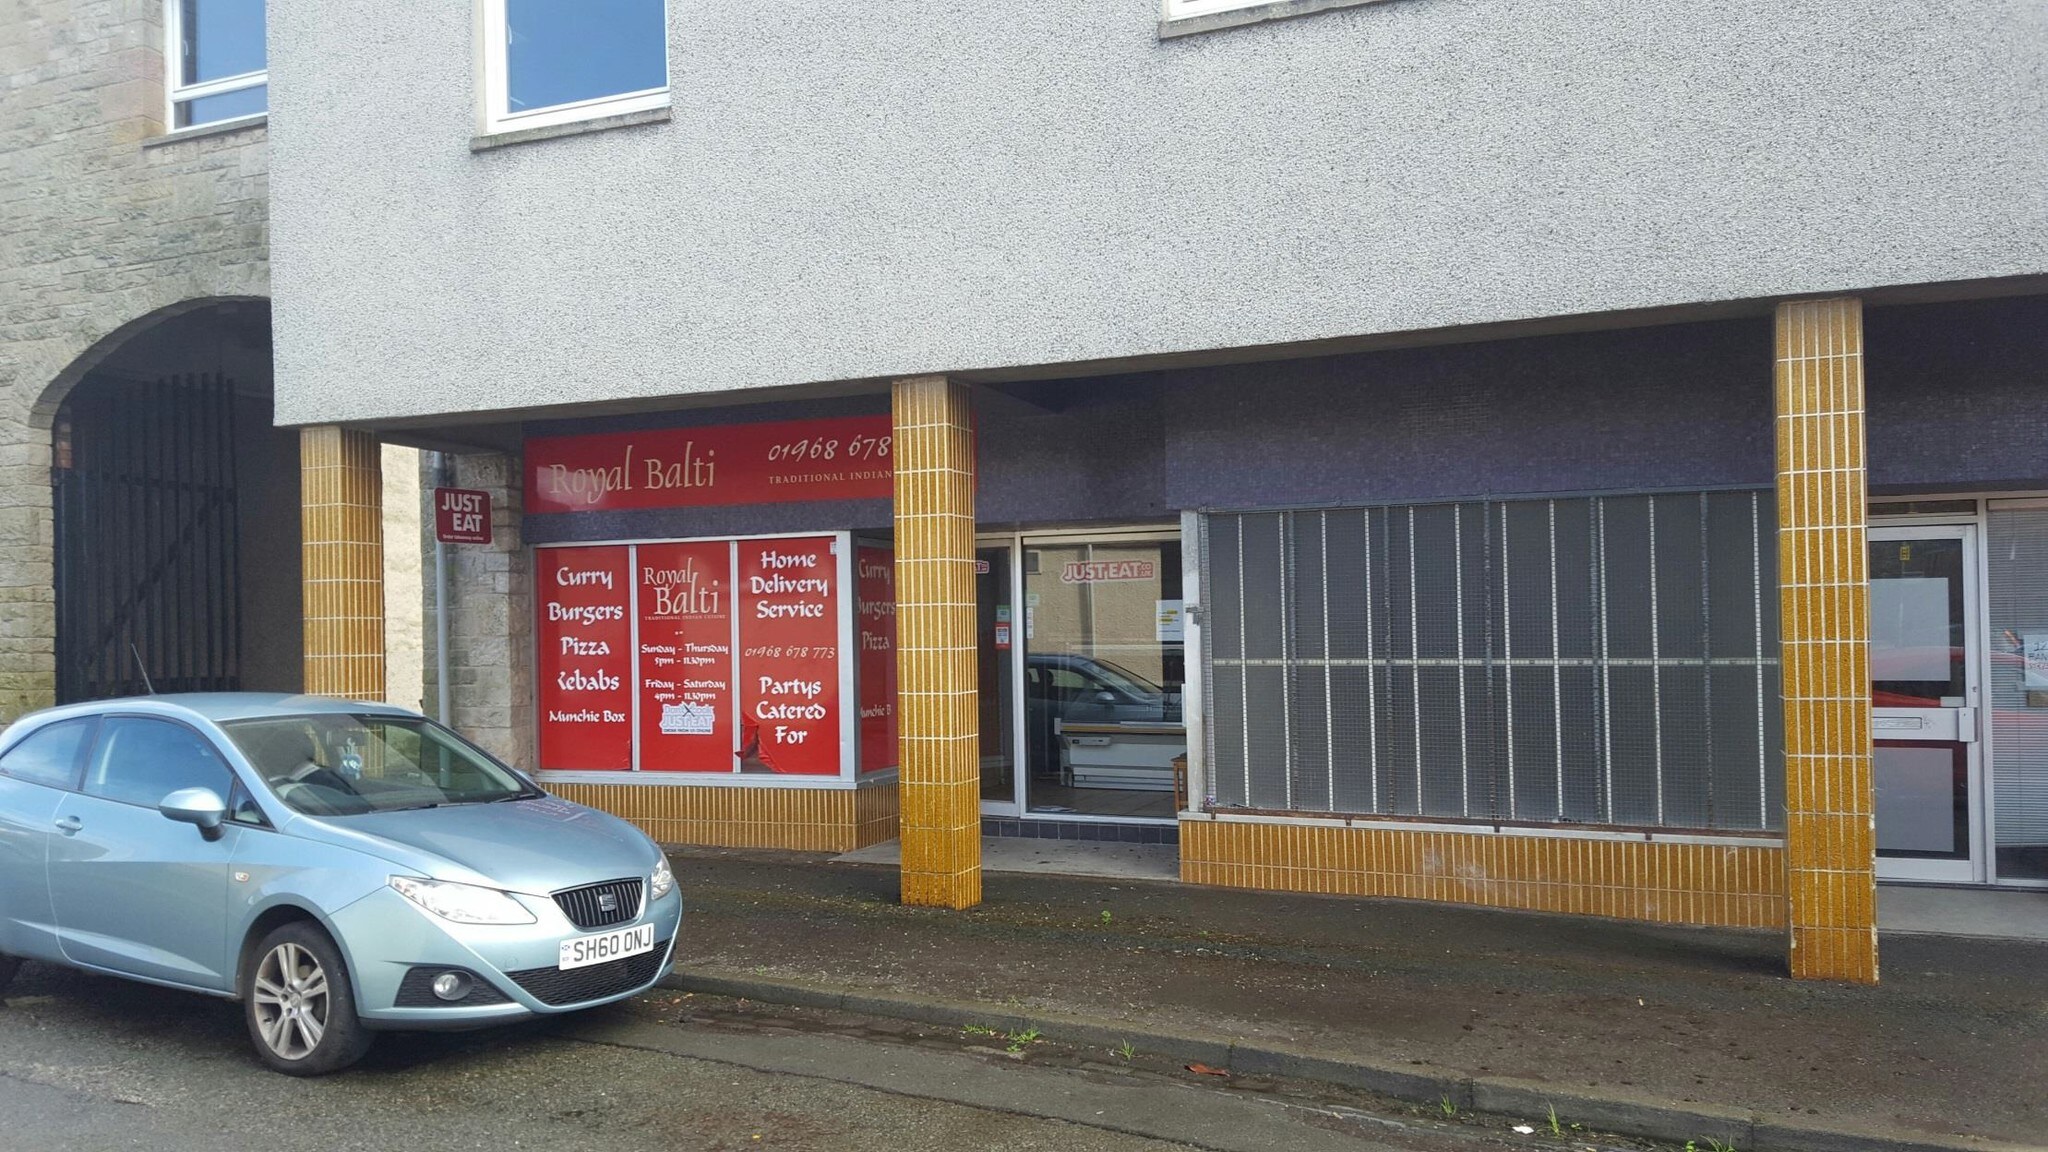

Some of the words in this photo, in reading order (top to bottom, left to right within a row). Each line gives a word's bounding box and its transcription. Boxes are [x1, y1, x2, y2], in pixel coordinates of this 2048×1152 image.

[768, 437, 838, 462] 01968
[848, 434, 892, 460] 678
[549, 444, 633, 504] Royal
[643, 441, 715, 490] Balti
[768, 472, 845, 484] TRADITIONAL
[850, 470, 893, 481] INDIAN
[441, 493, 482, 513] JUST
[452, 513, 483, 532] EAT
[760, 551, 817, 569] Home
[556, 566, 613, 589] Curry
[643, 557, 693, 591] Royal
[858, 558, 891, 585] Curry
[1064, 563, 1106, 580] JUST
[1109, 562, 1141, 579] EAT
[653, 572, 719, 615] Balti
[750, 573, 829, 596] Delivery
[547, 602, 624, 625] Burgers
[756, 600, 824, 619] Service
[560, 636, 611, 655] Pizza
[641, 643, 676, 656] Sunday
[684, 642, 729, 655] Thursday
[862, 631, 890, 650] Pizza
[745, 645, 781, 658] 01968
[786, 645, 809, 659] 678
[812, 647, 835, 659] 773
[654, 657, 675, 668] 5pm
[557, 668, 620, 691] Kebabs
[645, 679, 675, 691] Friday
[683, 679, 726, 692] Saturday
[759, 676, 822, 699] Partys
[654, 693, 676, 703] 4pm
[549, 708, 600, 723] Munchie
[602, 709, 626, 722] Box
[756, 701, 827, 720] Catered
[774, 727, 808, 744] For
[573, 934, 620, 962] SH60
[624, 926, 651, 952] ONJ
